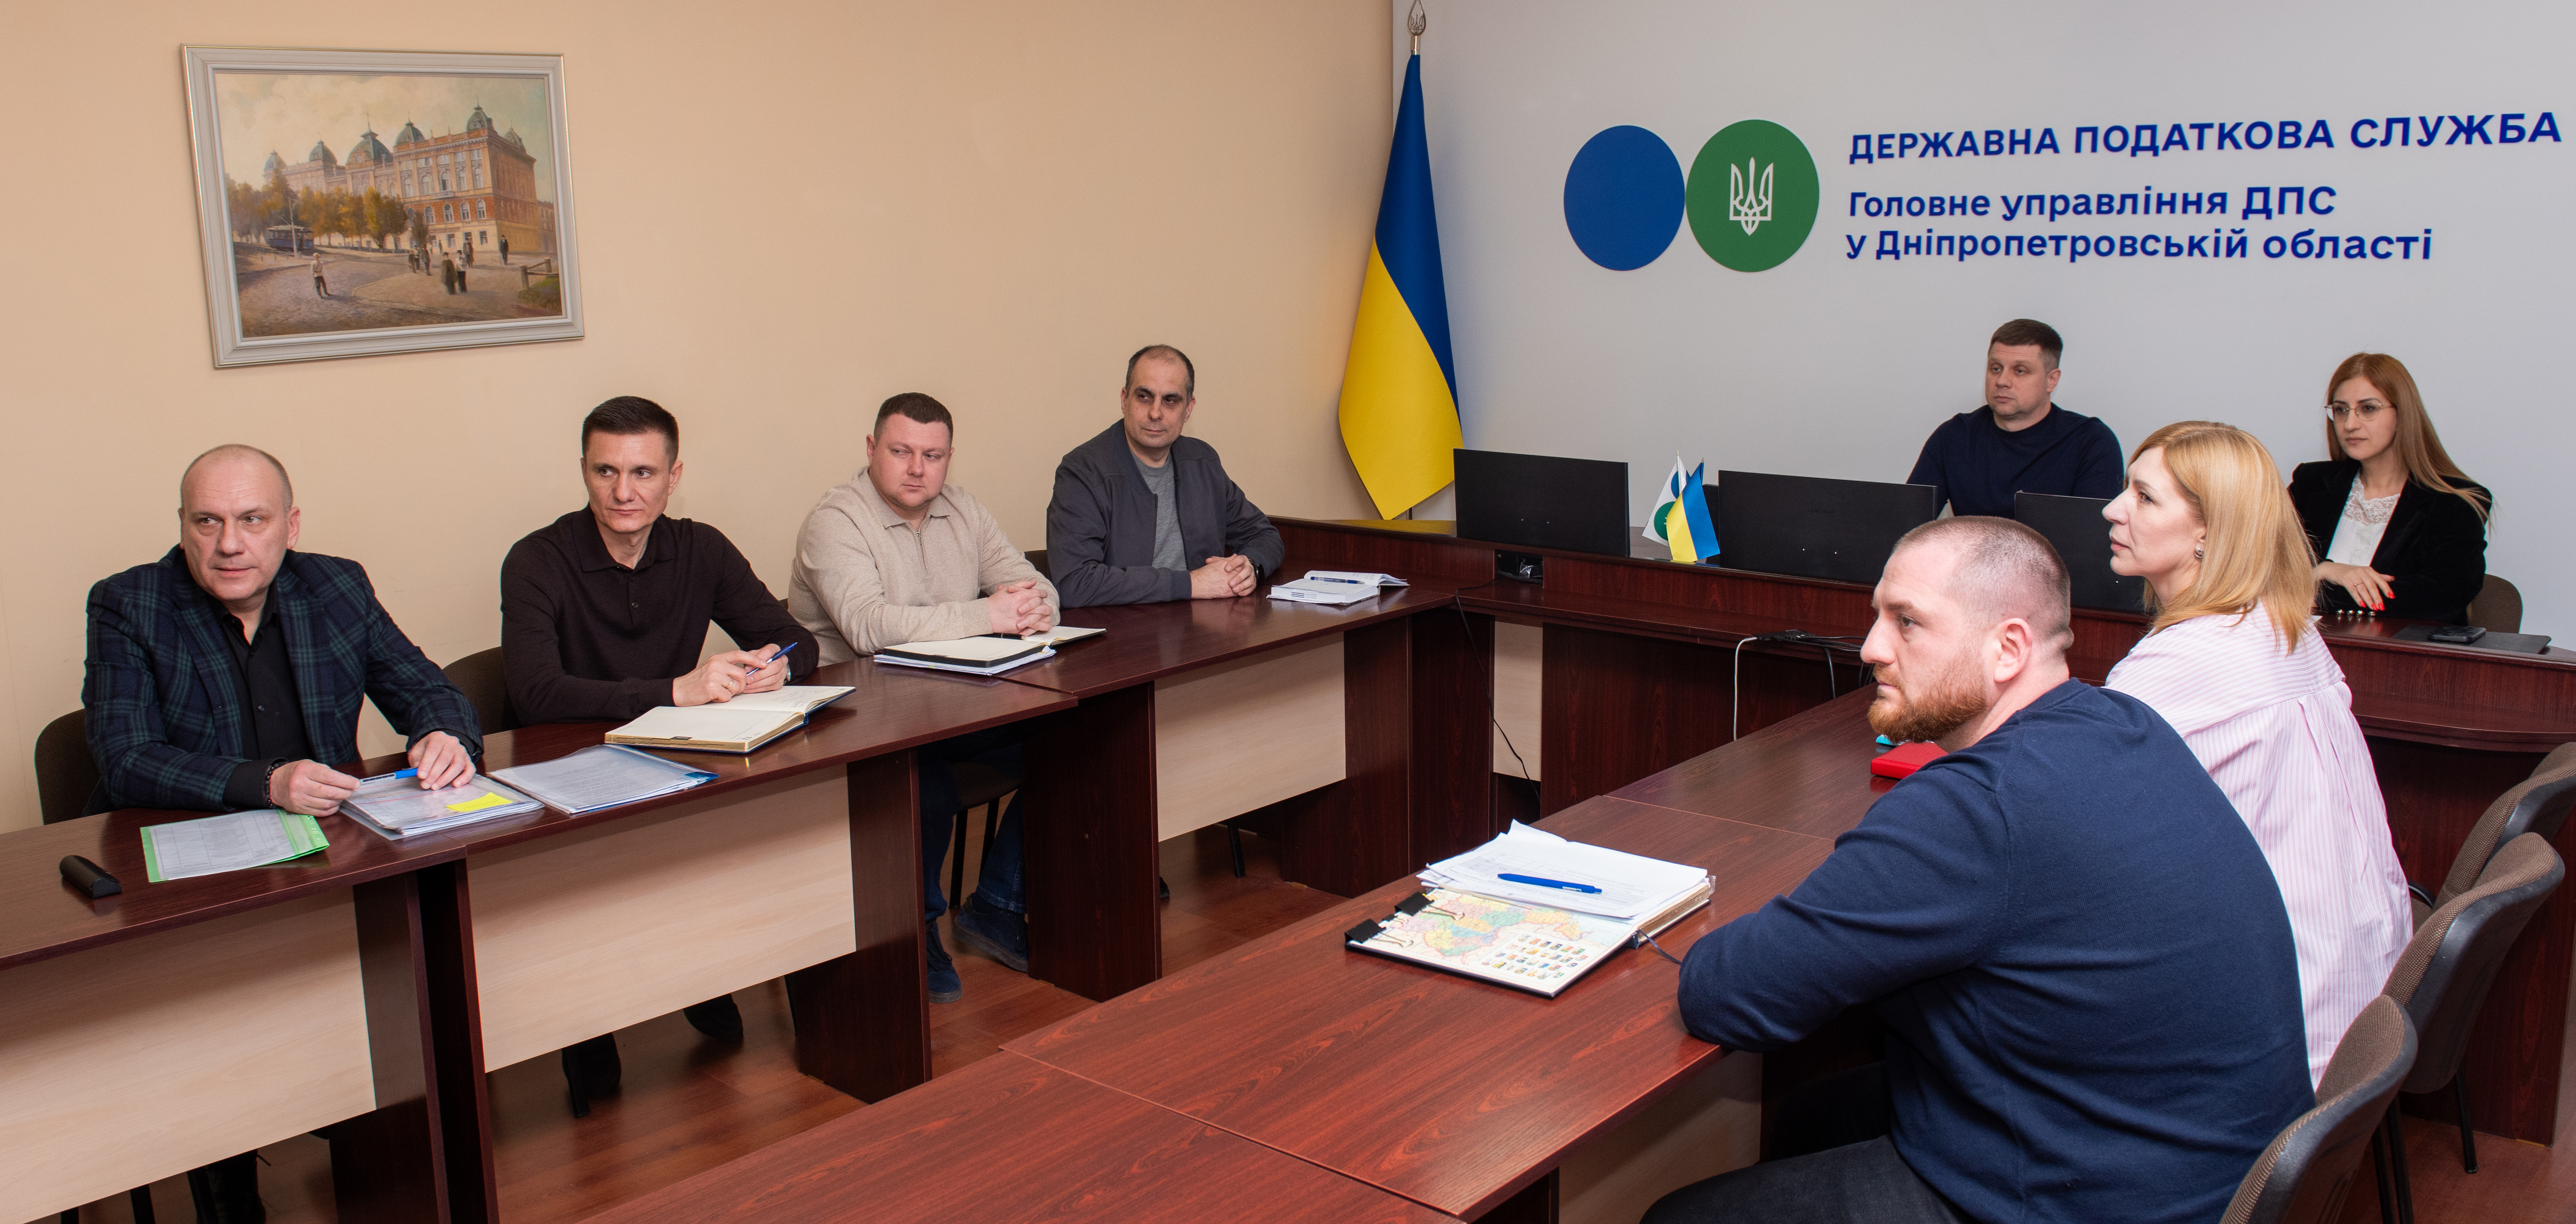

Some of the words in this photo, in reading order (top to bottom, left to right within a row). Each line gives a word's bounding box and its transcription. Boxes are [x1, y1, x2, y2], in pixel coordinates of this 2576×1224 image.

[1850, 127, 2060, 164] ДЕРЖАВНА
[2075, 119, 2335, 157] ПОДАТКОВА
[2351, 111, 2562, 148] СЛУЖБА
[1850, 192, 1991, 217] Головне
[2001, 185, 2228, 222] управління
[2242, 186, 2337, 220] ДПС
[1846, 234, 1867, 259] у
[1876, 228, 2248, 263] Дніпропетровській
[2263, 228, 2432, 260] області
